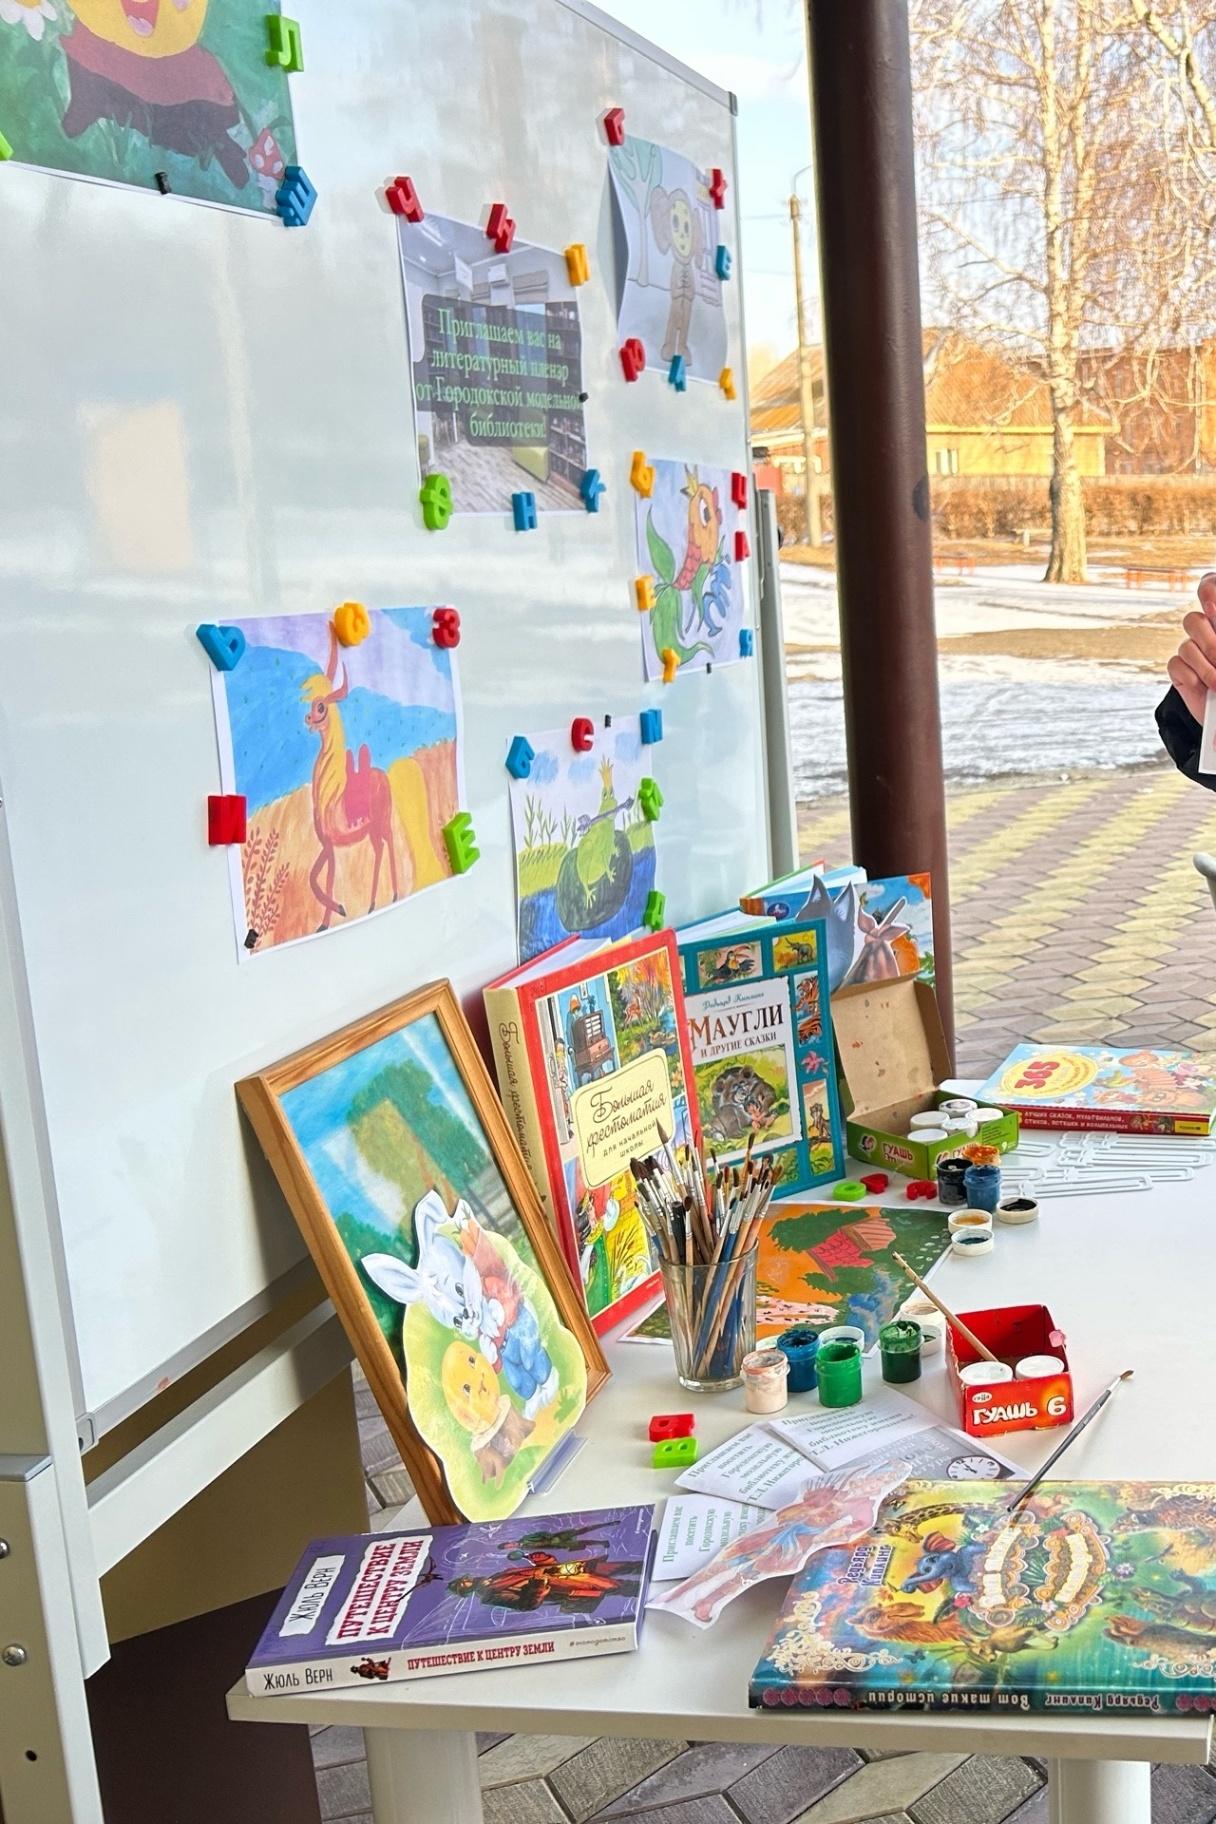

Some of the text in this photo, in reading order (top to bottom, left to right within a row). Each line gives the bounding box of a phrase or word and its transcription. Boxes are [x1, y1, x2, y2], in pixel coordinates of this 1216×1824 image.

[438, 308, 561, 350] Приглашаем вас на
[431, 350, 569, 387] литературный пленэр
[416, 383, 432, 400] от
[433, 376, 522, 411] Городокской
[688, 1003, 783, 1050] МАУГЛИ
[710, 1040, 742, 1057] ДРУГИЕ
[744, 1031, 777, 1047] СКАЗКИ
[590, 1079, 655, 1123] Большая
[587, 1093, 666, 1158] хрестоматия
[603, 1145, 617, 1157] для
[620, 1140, 644, 1157] школы
[973, 1396, 1067, 1425] ГУАШЬ 6
[305, 1566, 336, 1591] ВЕРН
[337, 1543, 396, 1639] ПУТЕШЕСТВИЕ
[367, 1540, 424, 1636] К ЦЕНТРУ ЗЕМЛИ
[407, 1641, 555, 1670] ПУТЕШЕСТВИЕ К ЦЕНТРУ ЗЕМЛИ
[305, 1667, 333, 1685] ВЕРН
[868, 1690, 1030, 1711] Вот такие истории
